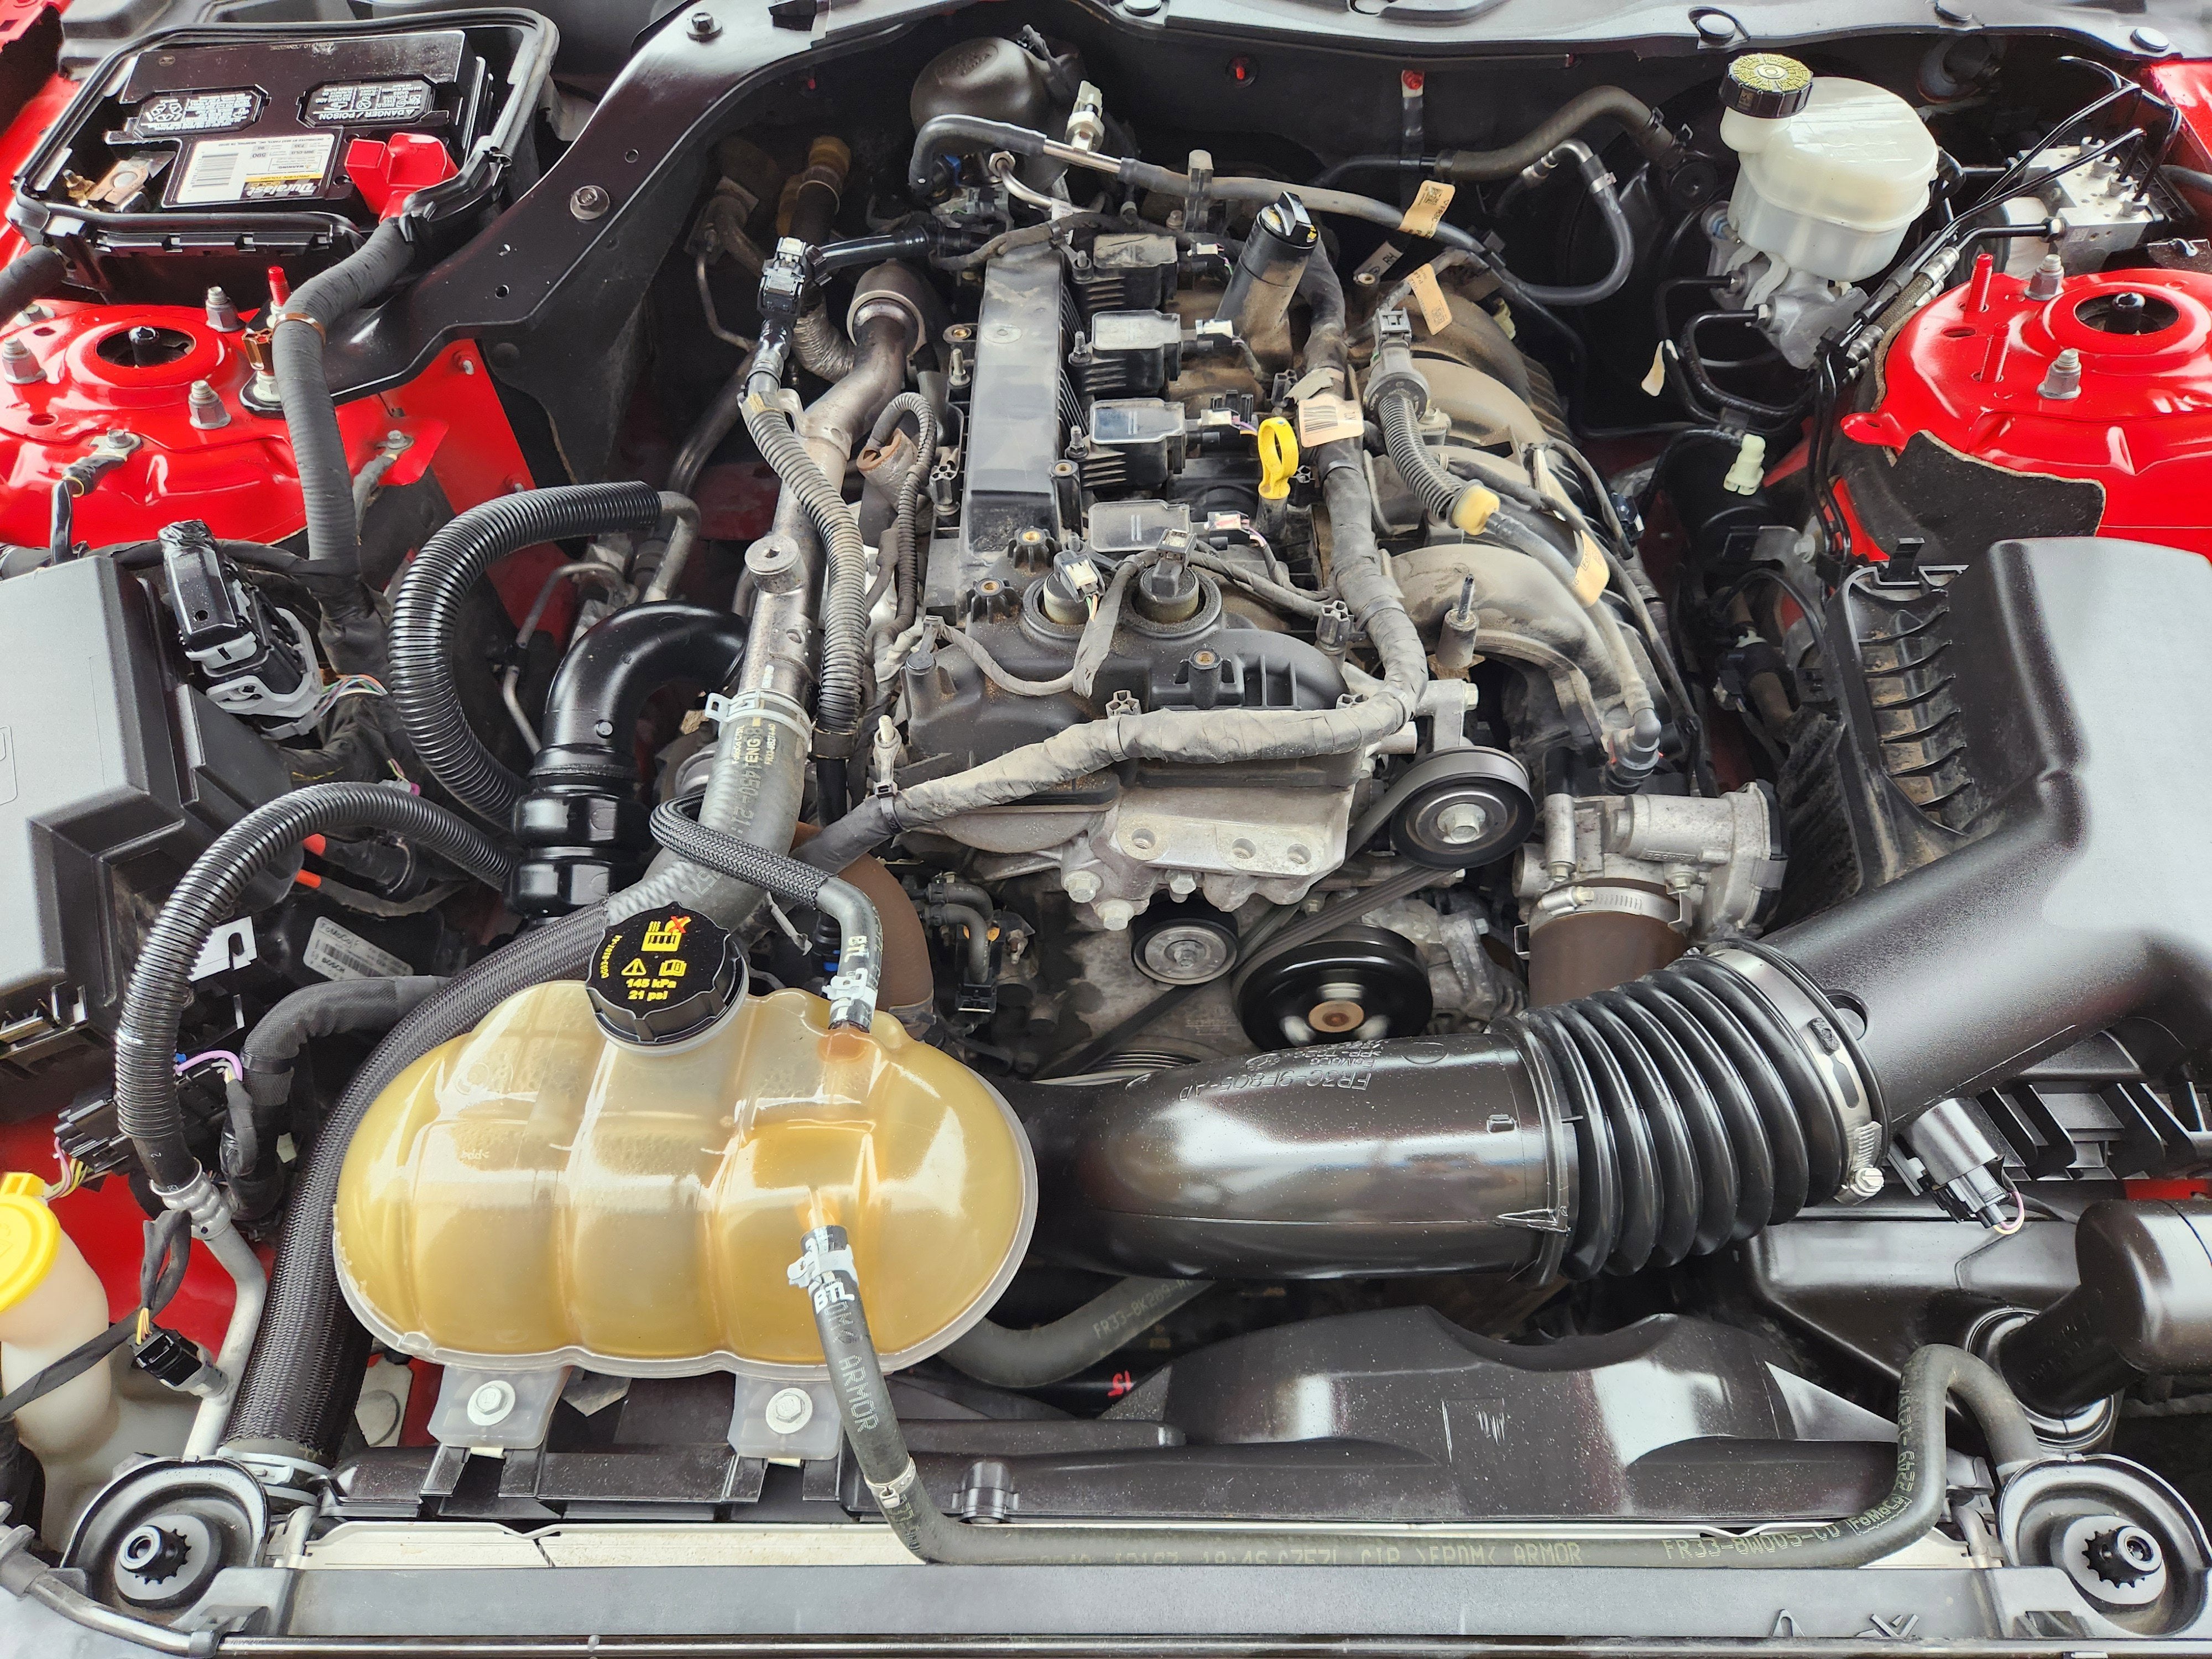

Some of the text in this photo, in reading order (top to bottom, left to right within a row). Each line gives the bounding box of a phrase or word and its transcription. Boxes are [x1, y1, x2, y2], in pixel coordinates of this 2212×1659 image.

[247, 182, 316, 196] Duralast
[745, 738, 762, 764] ENG
[625, 978, 677, 989] 145 kPa
[628, 990, 669, 1002] 21 psi
[1309, 1057, 1379, 1069] FoMoCo
[838, 1354, 880, 1433] ARMOR
[1851, 1495, 1906, 1530] FoMoCo
[1513, 1542, 1584, 1566] ARMOR
